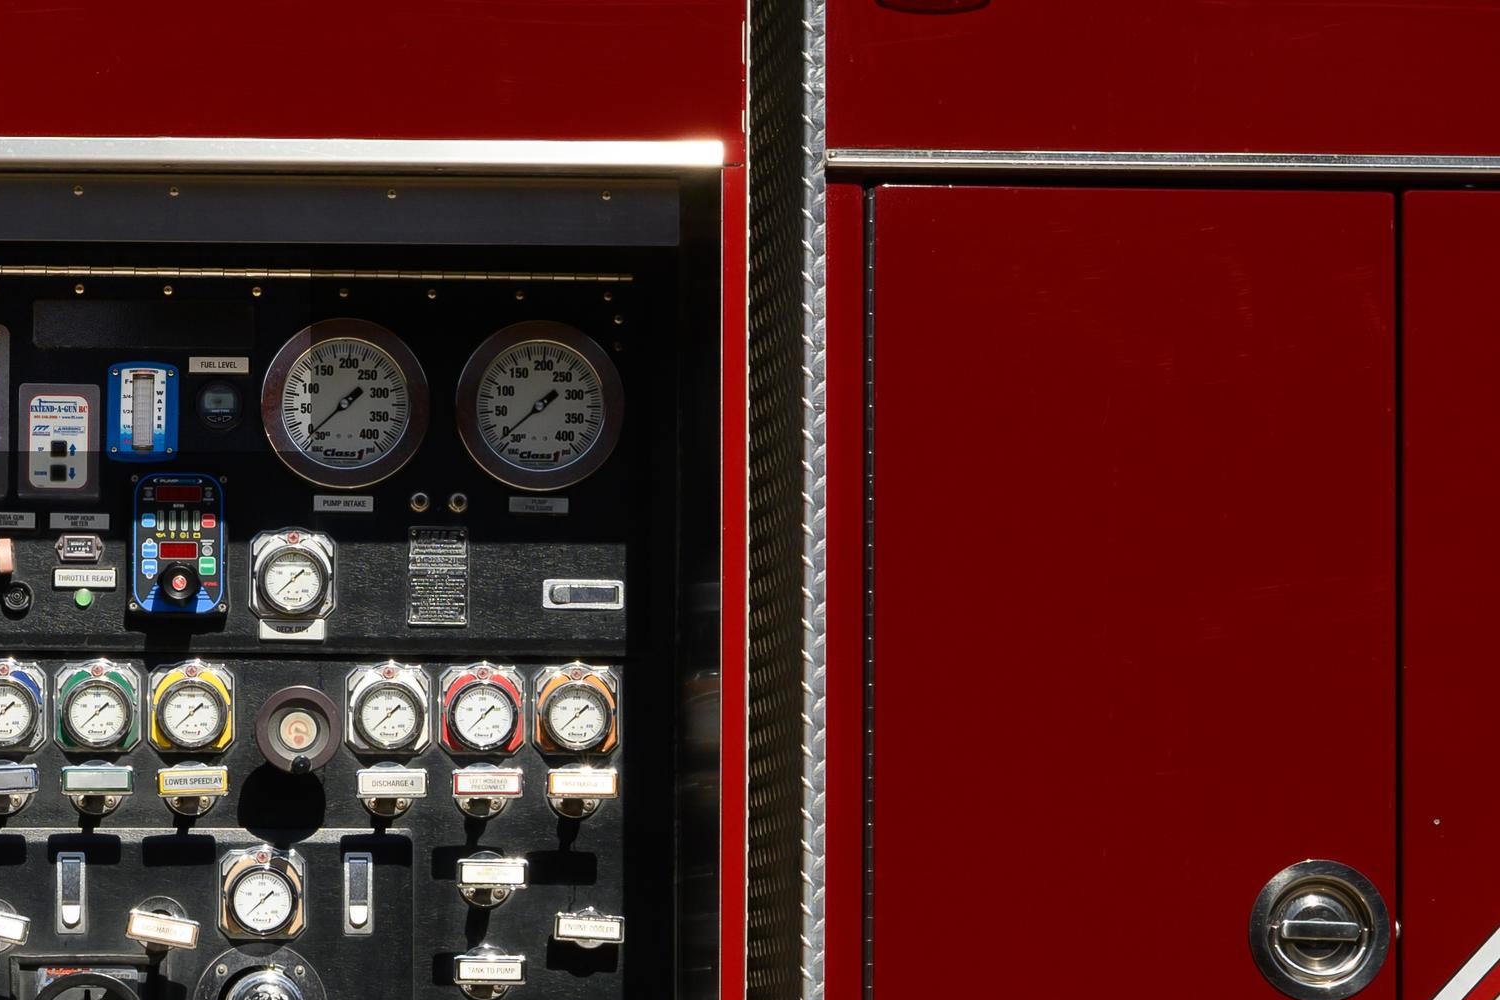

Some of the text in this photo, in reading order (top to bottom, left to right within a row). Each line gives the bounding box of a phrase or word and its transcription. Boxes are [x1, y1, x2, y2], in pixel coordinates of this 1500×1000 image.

[200, 361, 237, 369] FUEL LEVEL
[339, 358, 358, 369] 200
[533, 360, 553, 371] 200
[314, 365, 334, 376] 150
[357, 370, 377, 380] 250
[509, 367, 529, 378] 150
[552, 371, 572, 382] 250
[302, 383, 319, 394] 100
[370, 387, 389, 398] 300
[496, 385, 515, 396] 100
[564, 389, 584, 400] 300
[30, 405, 87, 413] EXTEND-A-GUN RC
[156, 390, 164, 429] WATER
[300, 403, 313, 414] 50
[494, 405, 507, 416] 50
[369, 411, 389, 422] 350
[565, 413, 584, 424] 350
[308, 423, 313, 434] 0
[359, 428, 379, 439] 400
[502, 426, 509, 436] 0
[555, 430, 575, 441] 400
[561, 448, 571, 456] psi
[343, 500, 366, 508] INTAKE
[58, 574, 89, 582] THROTTLE
[164, 777, 222, 786] LOWER SPEEDLAY
[589, 924, 614, 933] COOLER
[496, 967, 515, 975] PUMP
